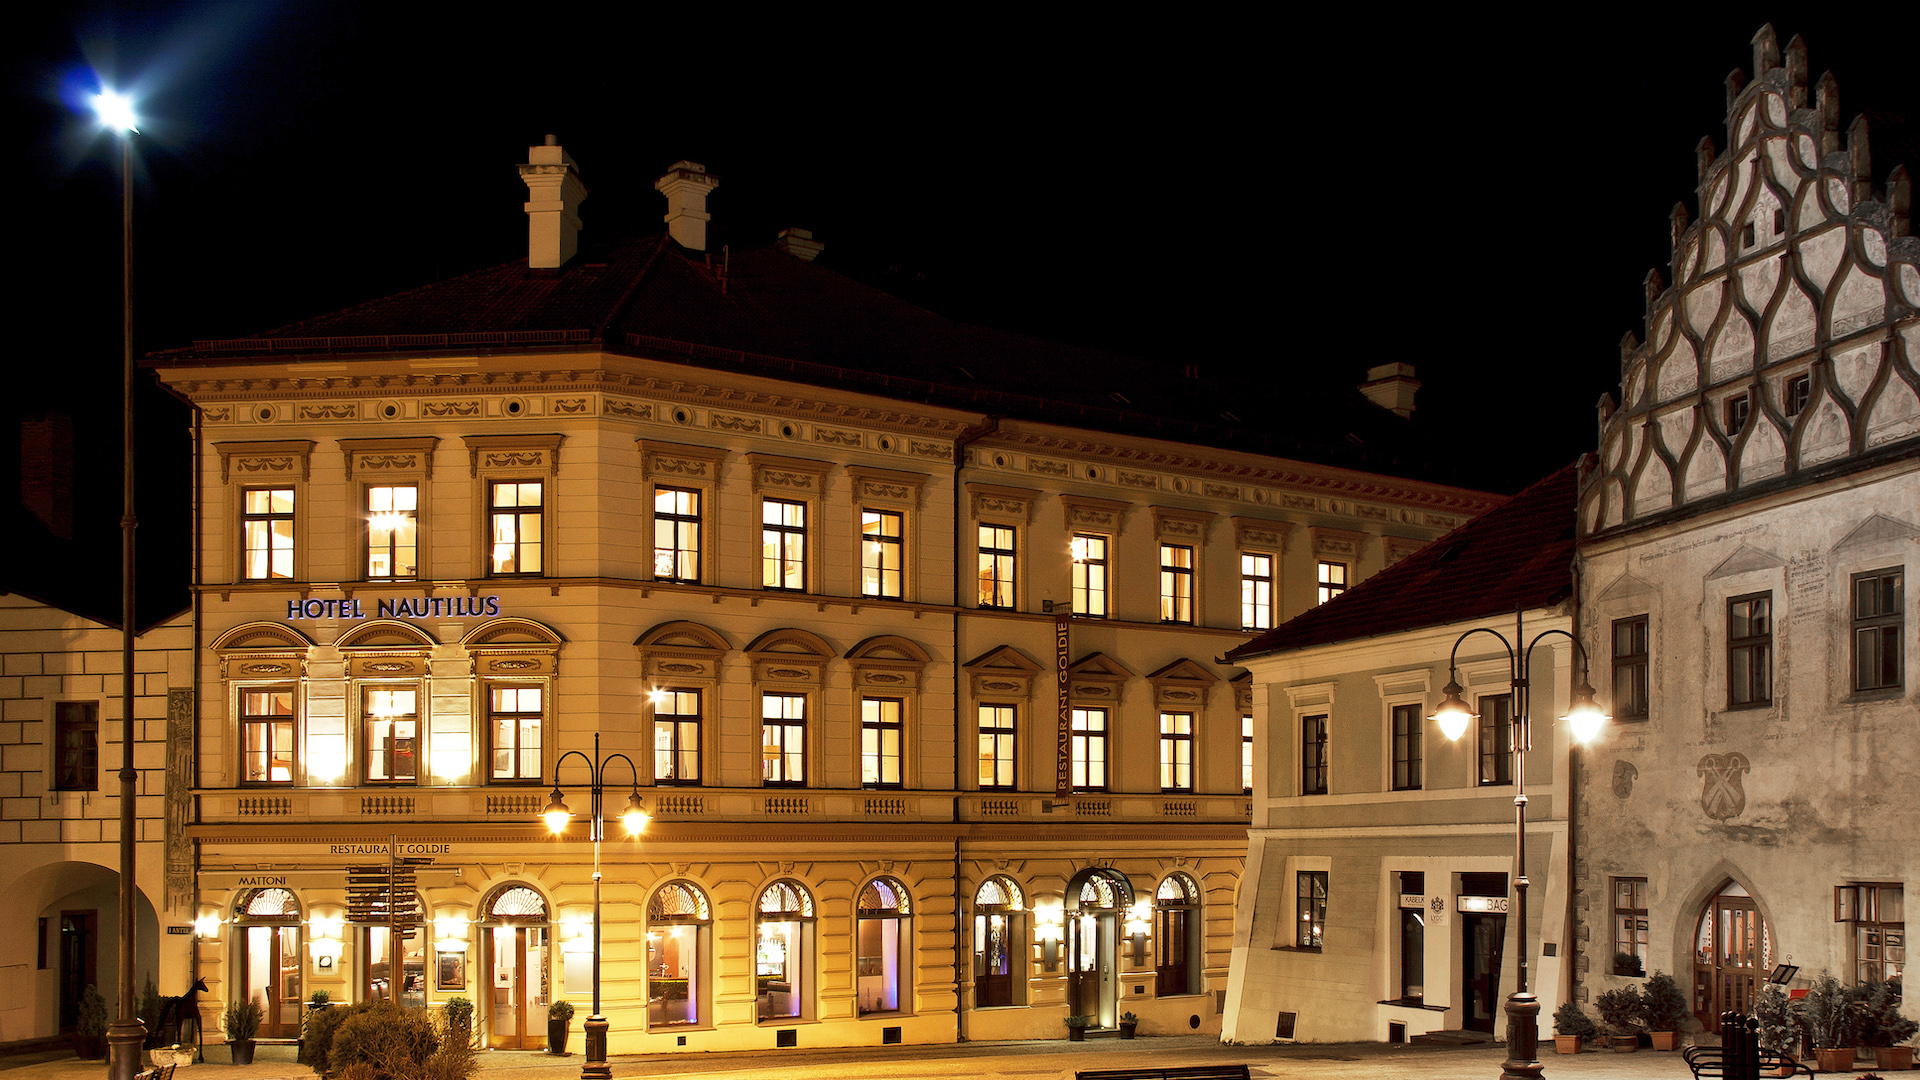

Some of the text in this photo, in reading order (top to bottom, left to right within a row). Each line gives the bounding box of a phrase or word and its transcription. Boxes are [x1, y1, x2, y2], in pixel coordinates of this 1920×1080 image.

[286, 596, 500, 620] HOTEL NAUTILUS
[1058, 622, 1068, 790] RESTAURANT GOLDIE
[330, 844, 450, 854] RESTAURAT GOLDIE
[238, 876, 286, 885] MATTONI
[1486, 898, 1508, 912] BAG
